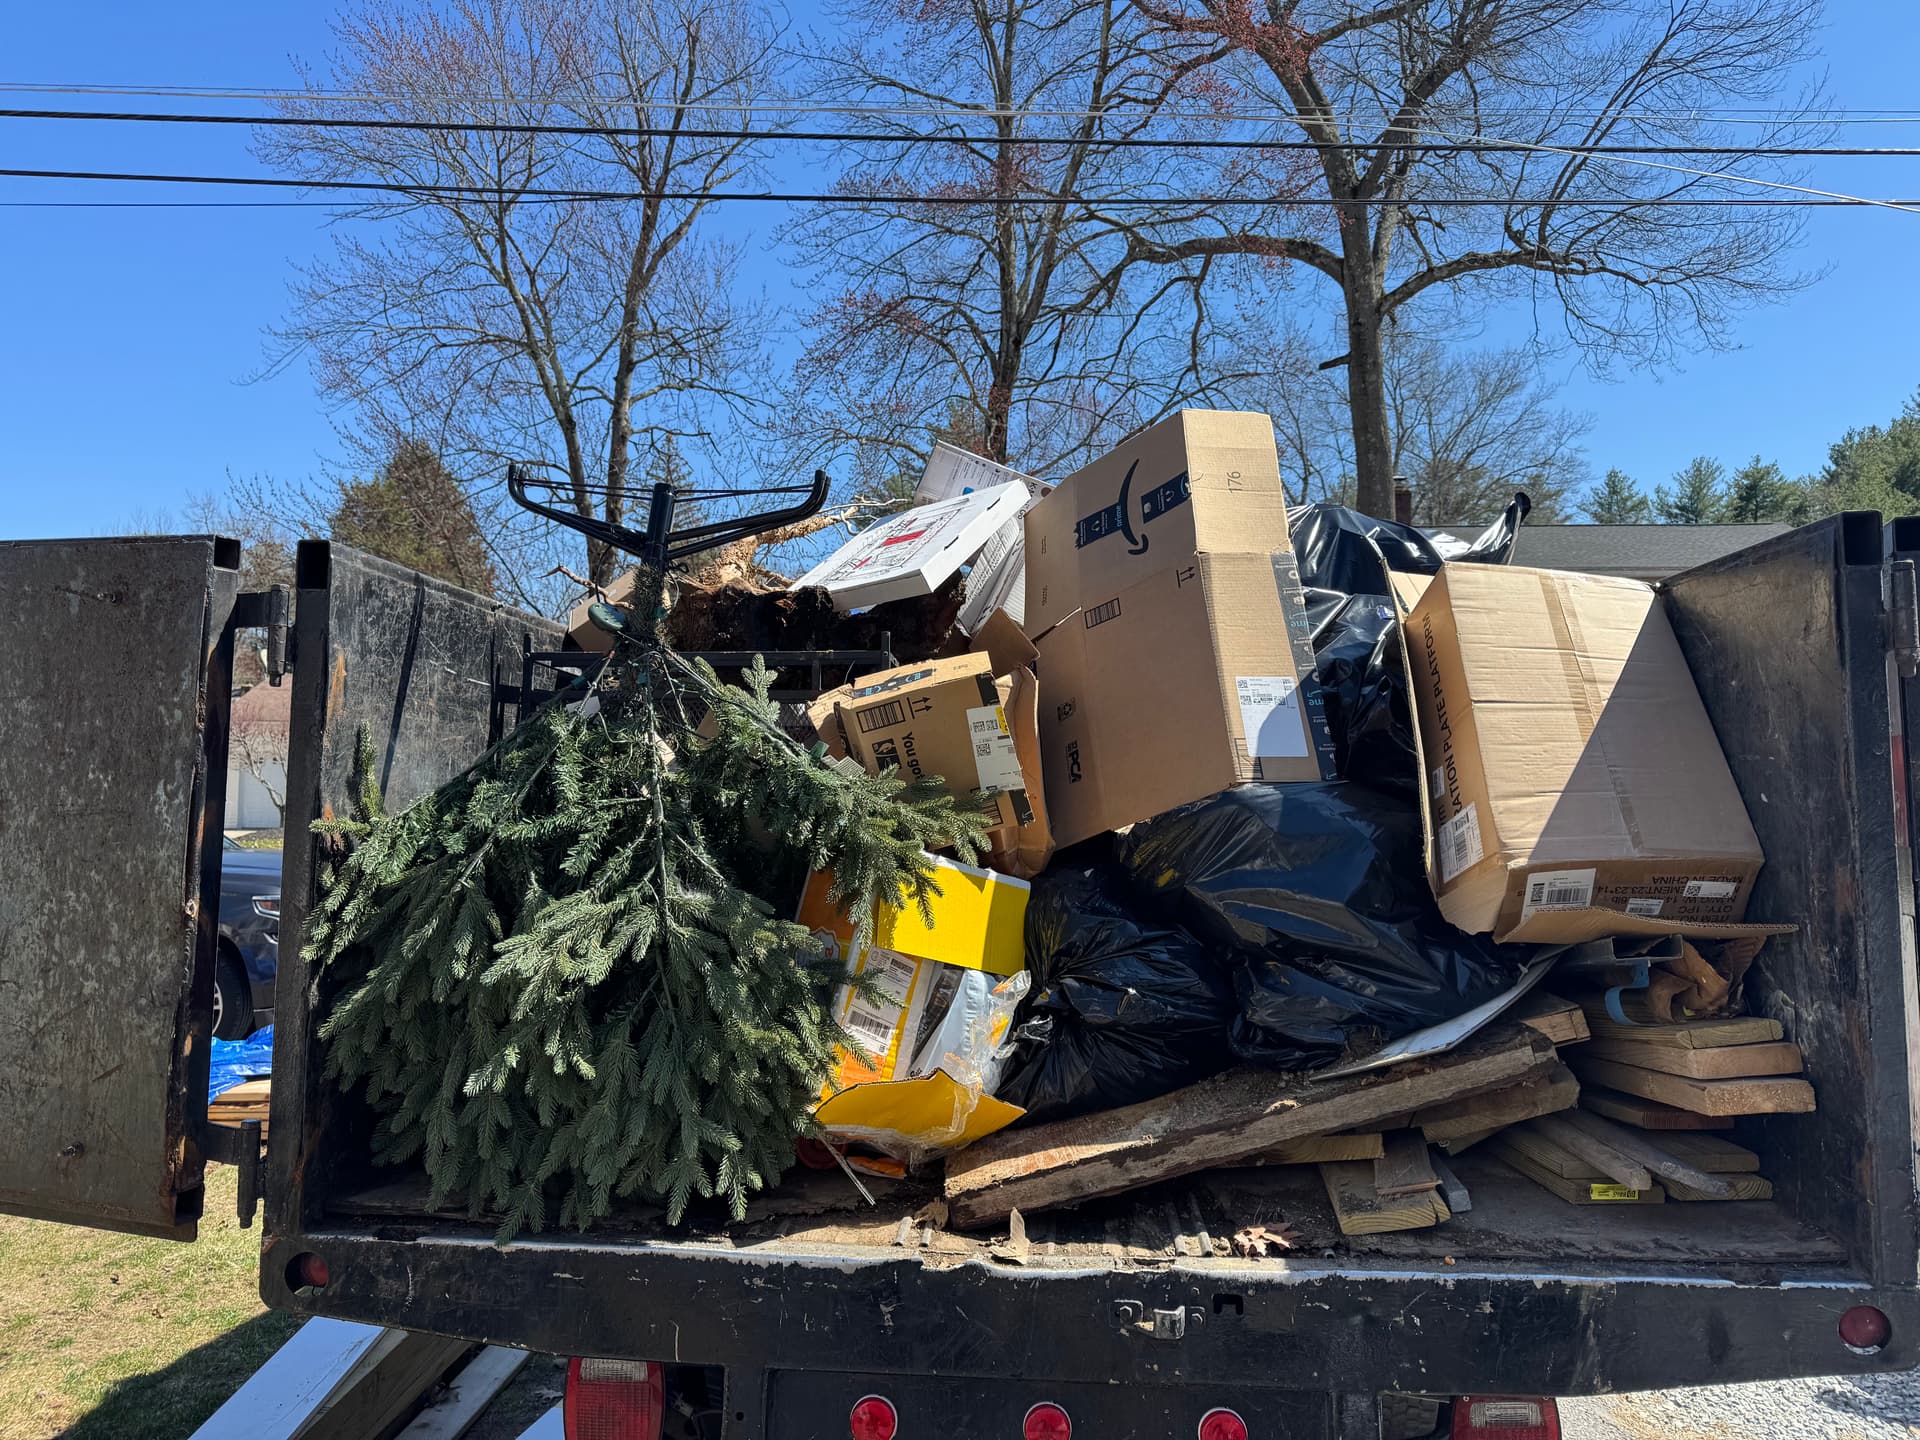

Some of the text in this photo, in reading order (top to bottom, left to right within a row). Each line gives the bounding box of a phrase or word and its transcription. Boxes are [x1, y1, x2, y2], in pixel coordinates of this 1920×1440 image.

[1226, 471, 1243, 493] 176
[1423, 612, 1442, 698] PLATFORM
[1437, 697, 1452, 753] PLATE
[902, 731, 915, 757] You
[1652, 876, 1688, 884] CHINA
